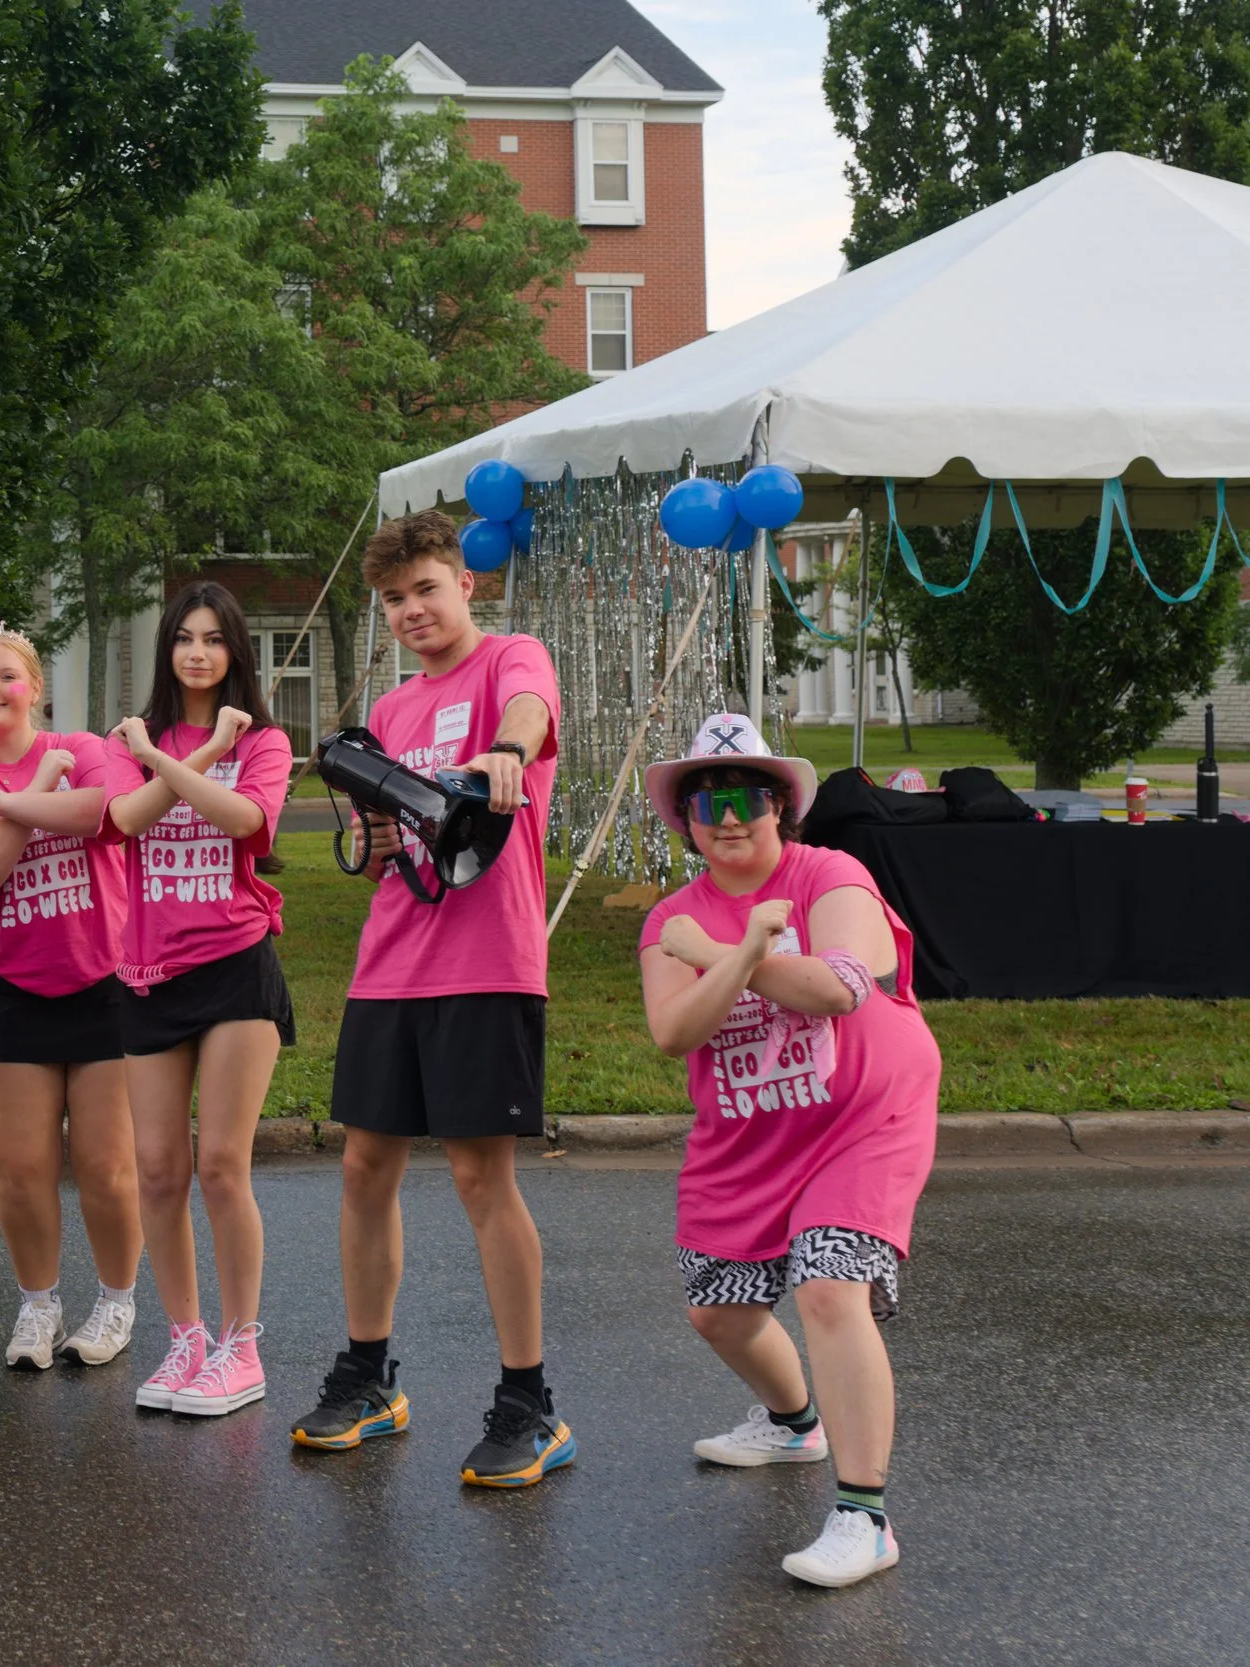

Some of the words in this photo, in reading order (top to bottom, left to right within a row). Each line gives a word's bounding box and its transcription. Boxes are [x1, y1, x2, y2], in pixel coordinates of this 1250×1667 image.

[705, 724, 748, 755] X
[149, 826, 177, 839] LET'S
[179, 827, 196, 839] GET
[400, 808, 422, 831] PYLE
[152, 847, 176, 868] GO
[184, 848, 195, 869] X
[200, 845, 230, 868] GO!
[16, 868, 36, 891] GO
[41, 863, 52, 885] X
[58, 856, 85, 881] GO!
[150, 875, 234, 903] O-WEEK
[17, 884, 95, 925] O-WEEK
[731, 1051, 759, 1079] GO
